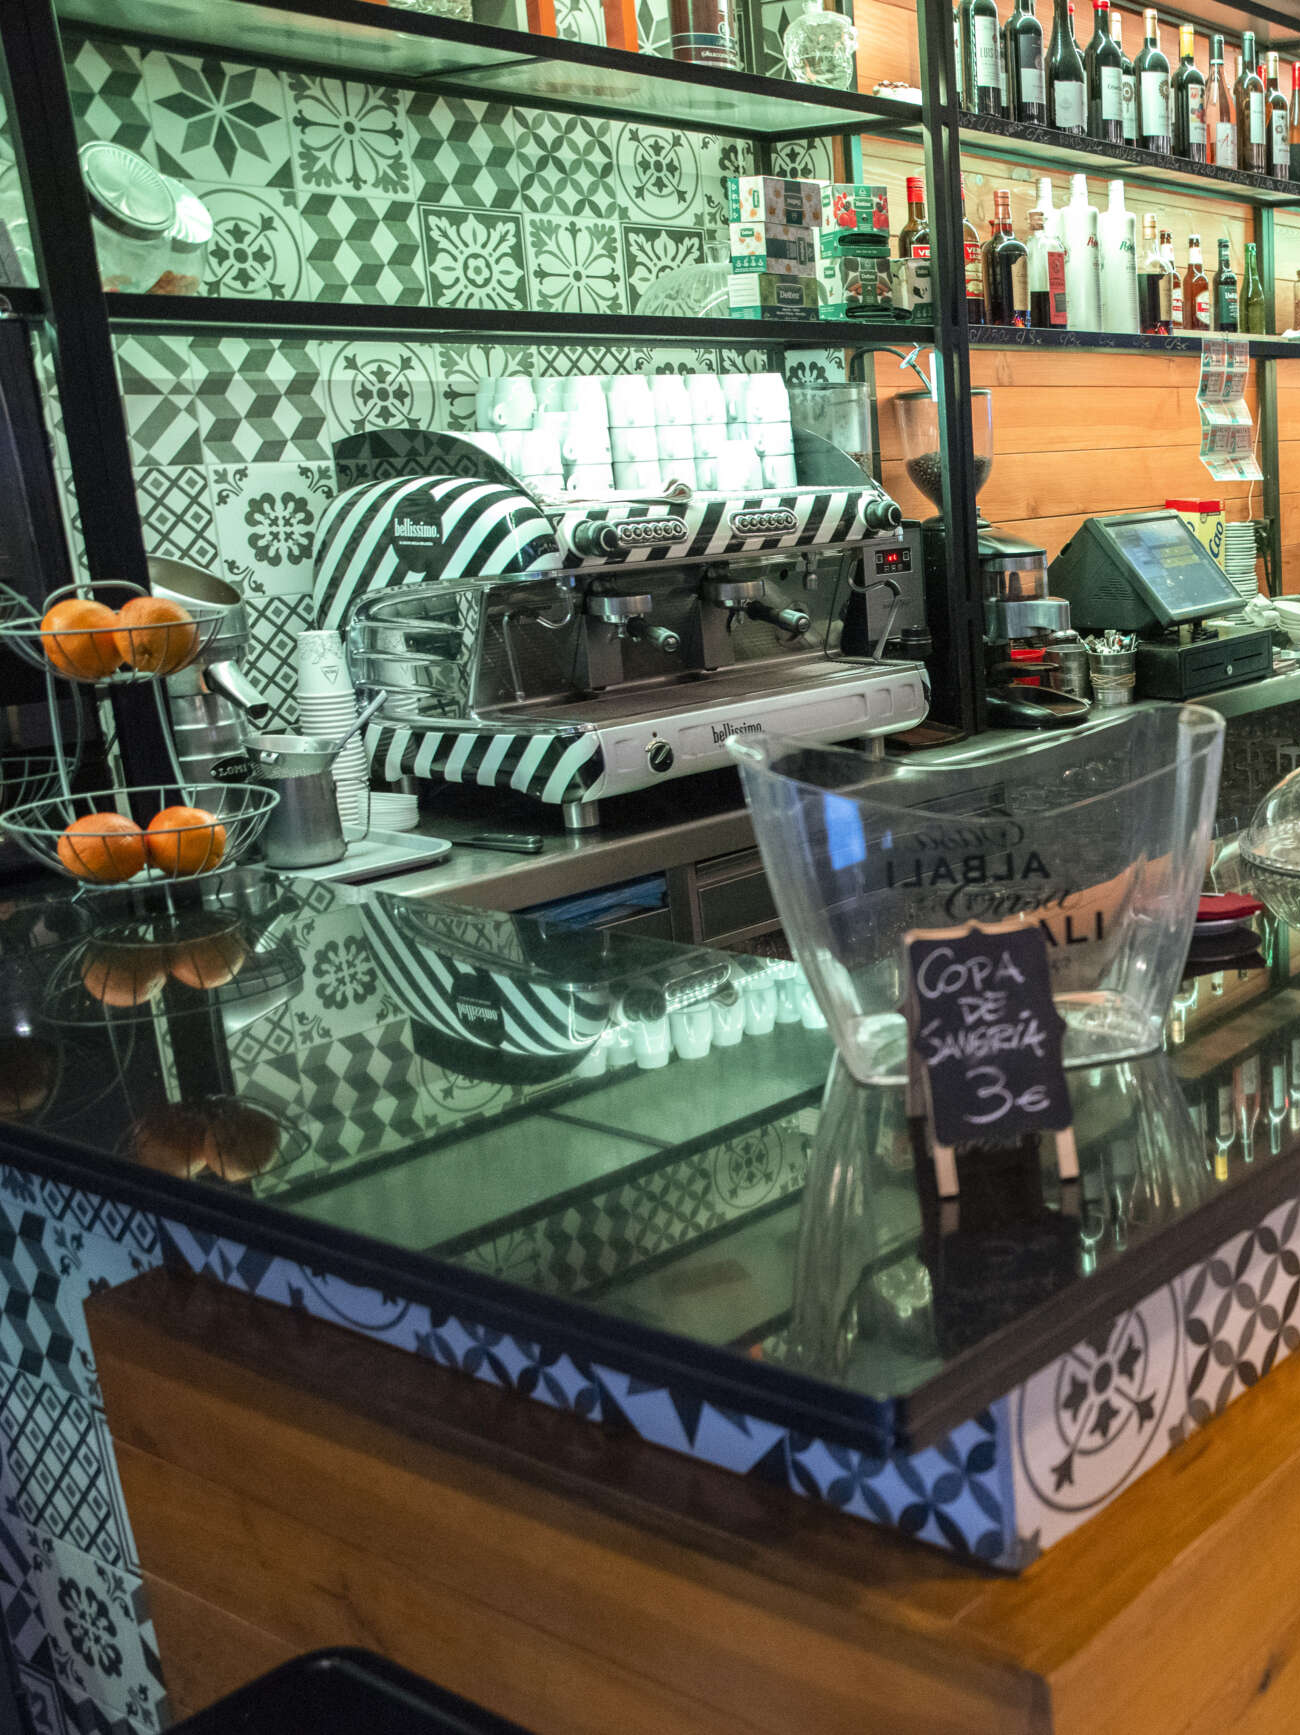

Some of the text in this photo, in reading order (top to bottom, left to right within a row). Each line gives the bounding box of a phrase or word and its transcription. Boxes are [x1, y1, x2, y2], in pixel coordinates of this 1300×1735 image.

[394, 517, 440, 538] bellissimo.
[1208, 521, 1224, 559] Cao
[917, 947, 1026, 999] COPA
[957, 990, 1008, 1027] DE
